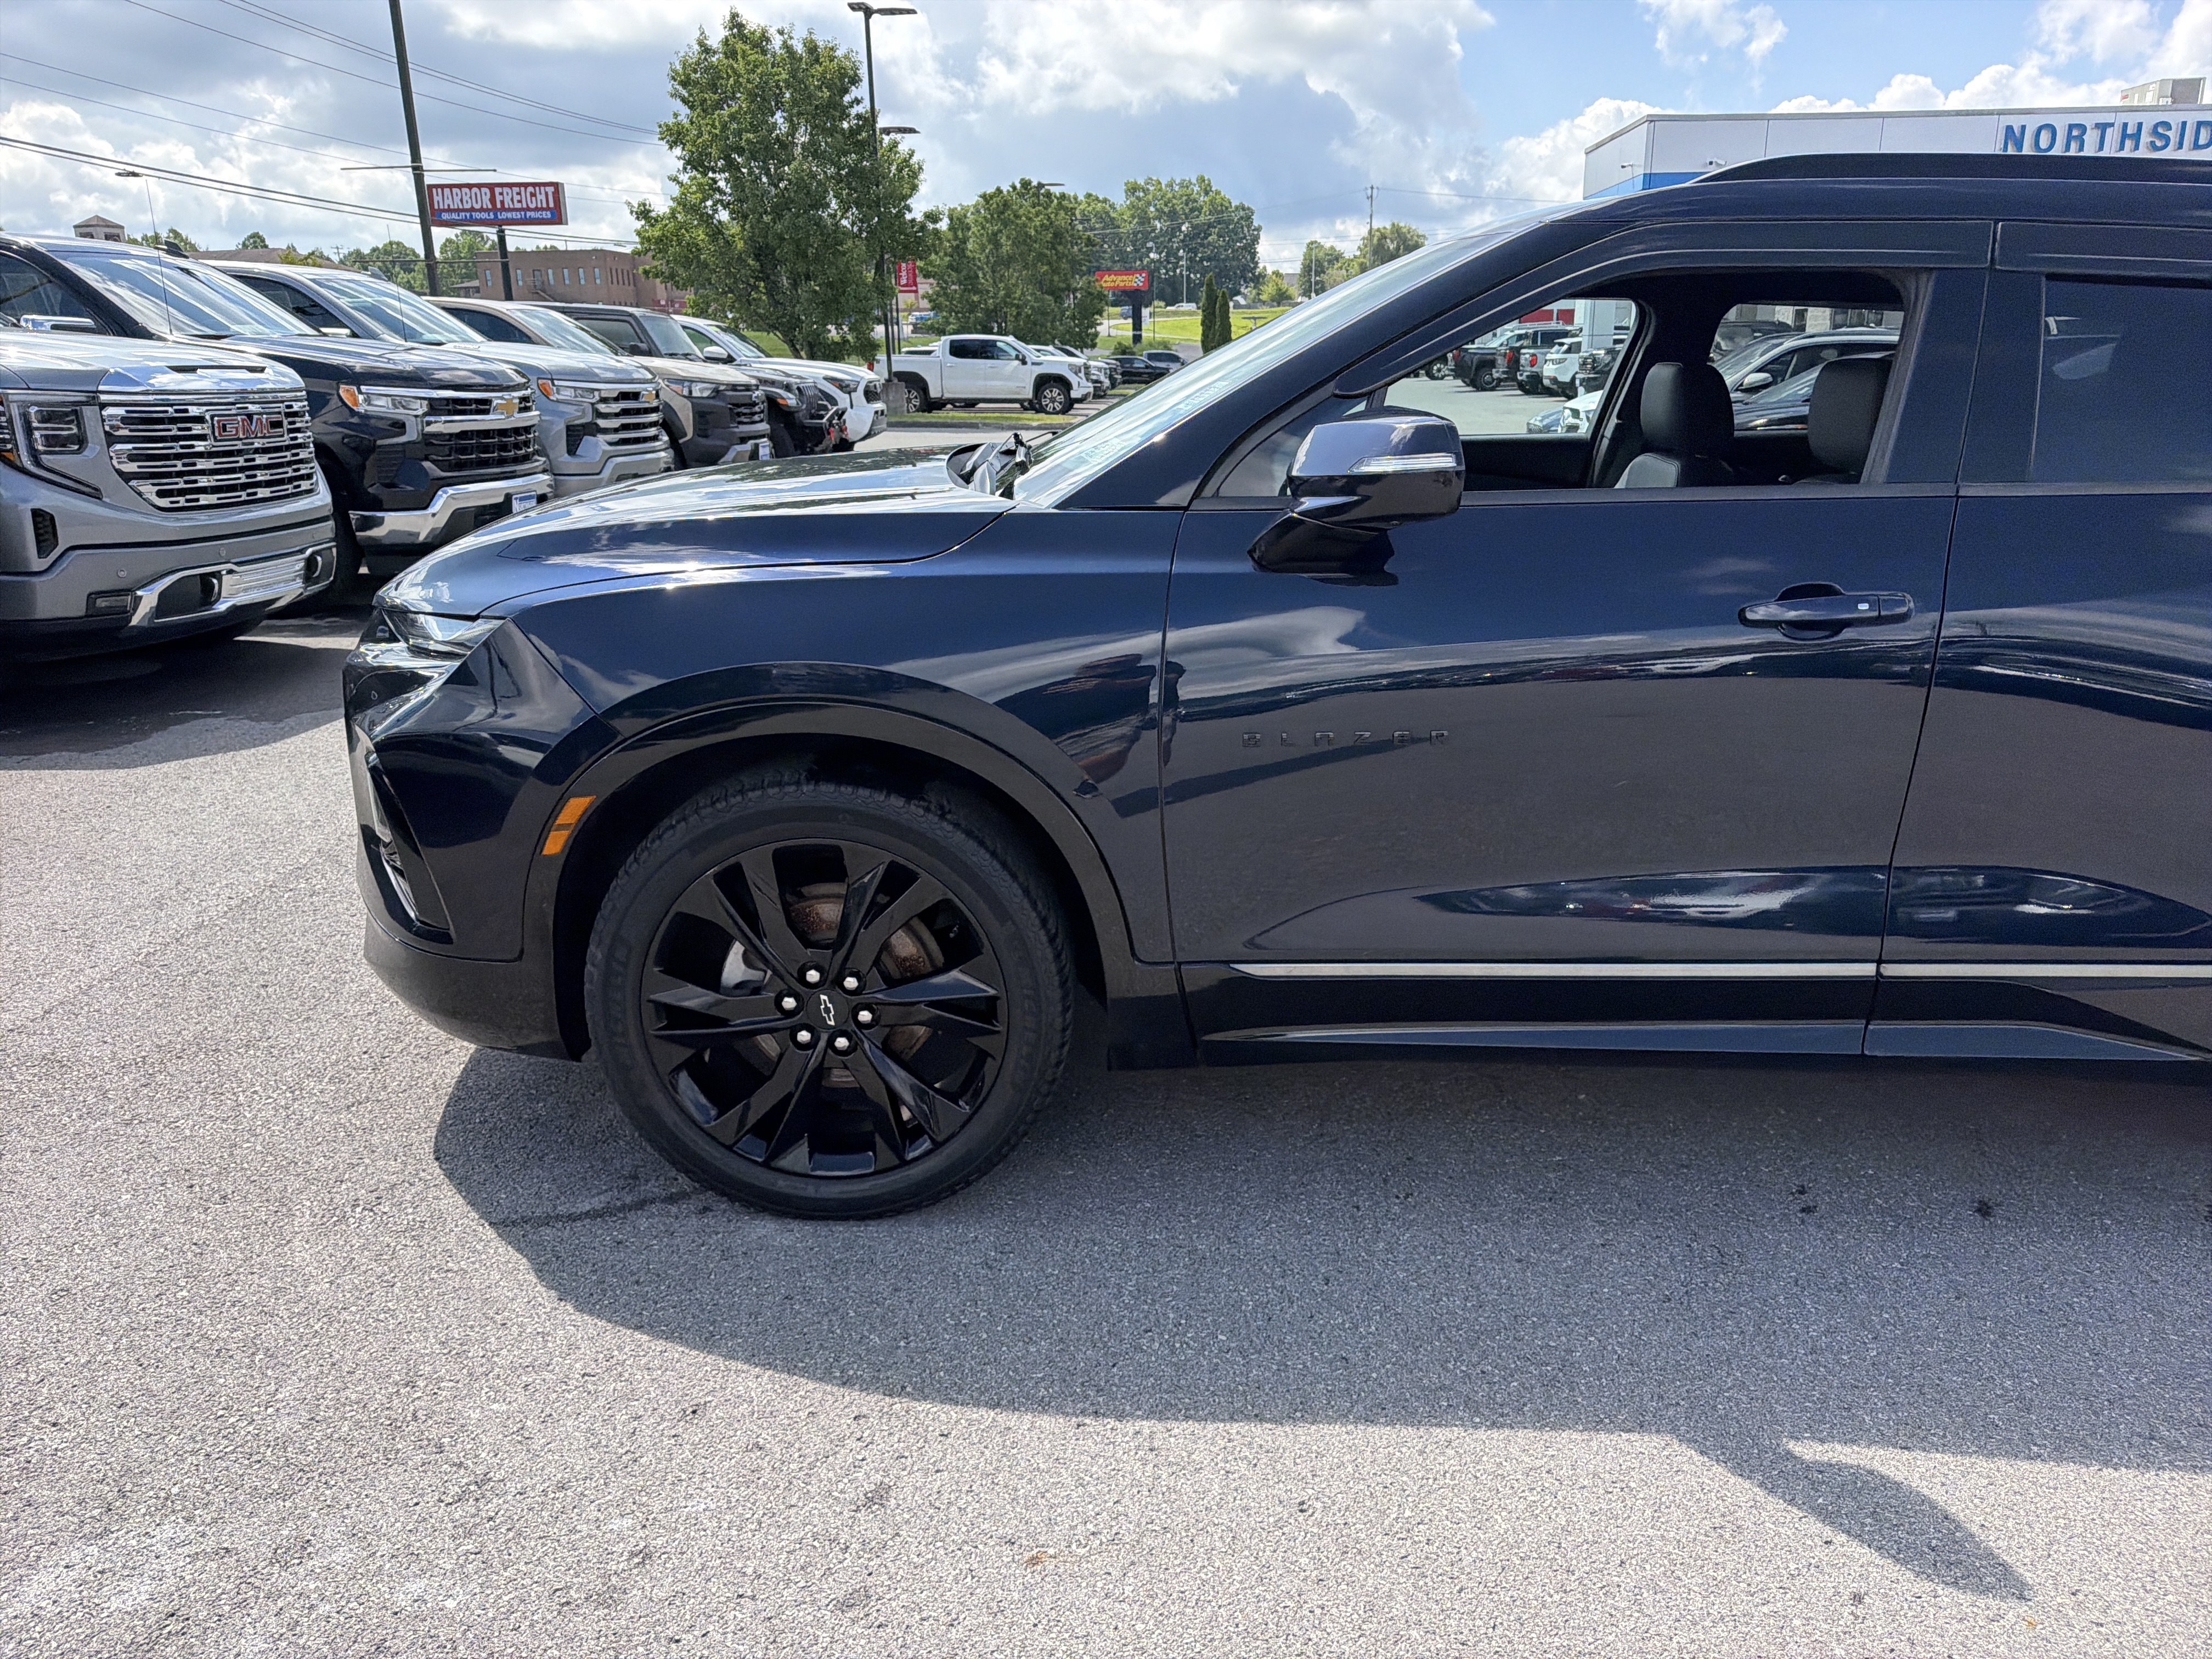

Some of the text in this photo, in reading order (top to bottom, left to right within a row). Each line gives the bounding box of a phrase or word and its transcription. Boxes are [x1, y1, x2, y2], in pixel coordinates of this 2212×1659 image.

[432, 186, 555, 209] HARBOR FREIGHT
[497, 211, 525, 219] LOWEST
[214, 415, 284, 439] GMC
[1242, 730, 1449, 748] BLAZER
